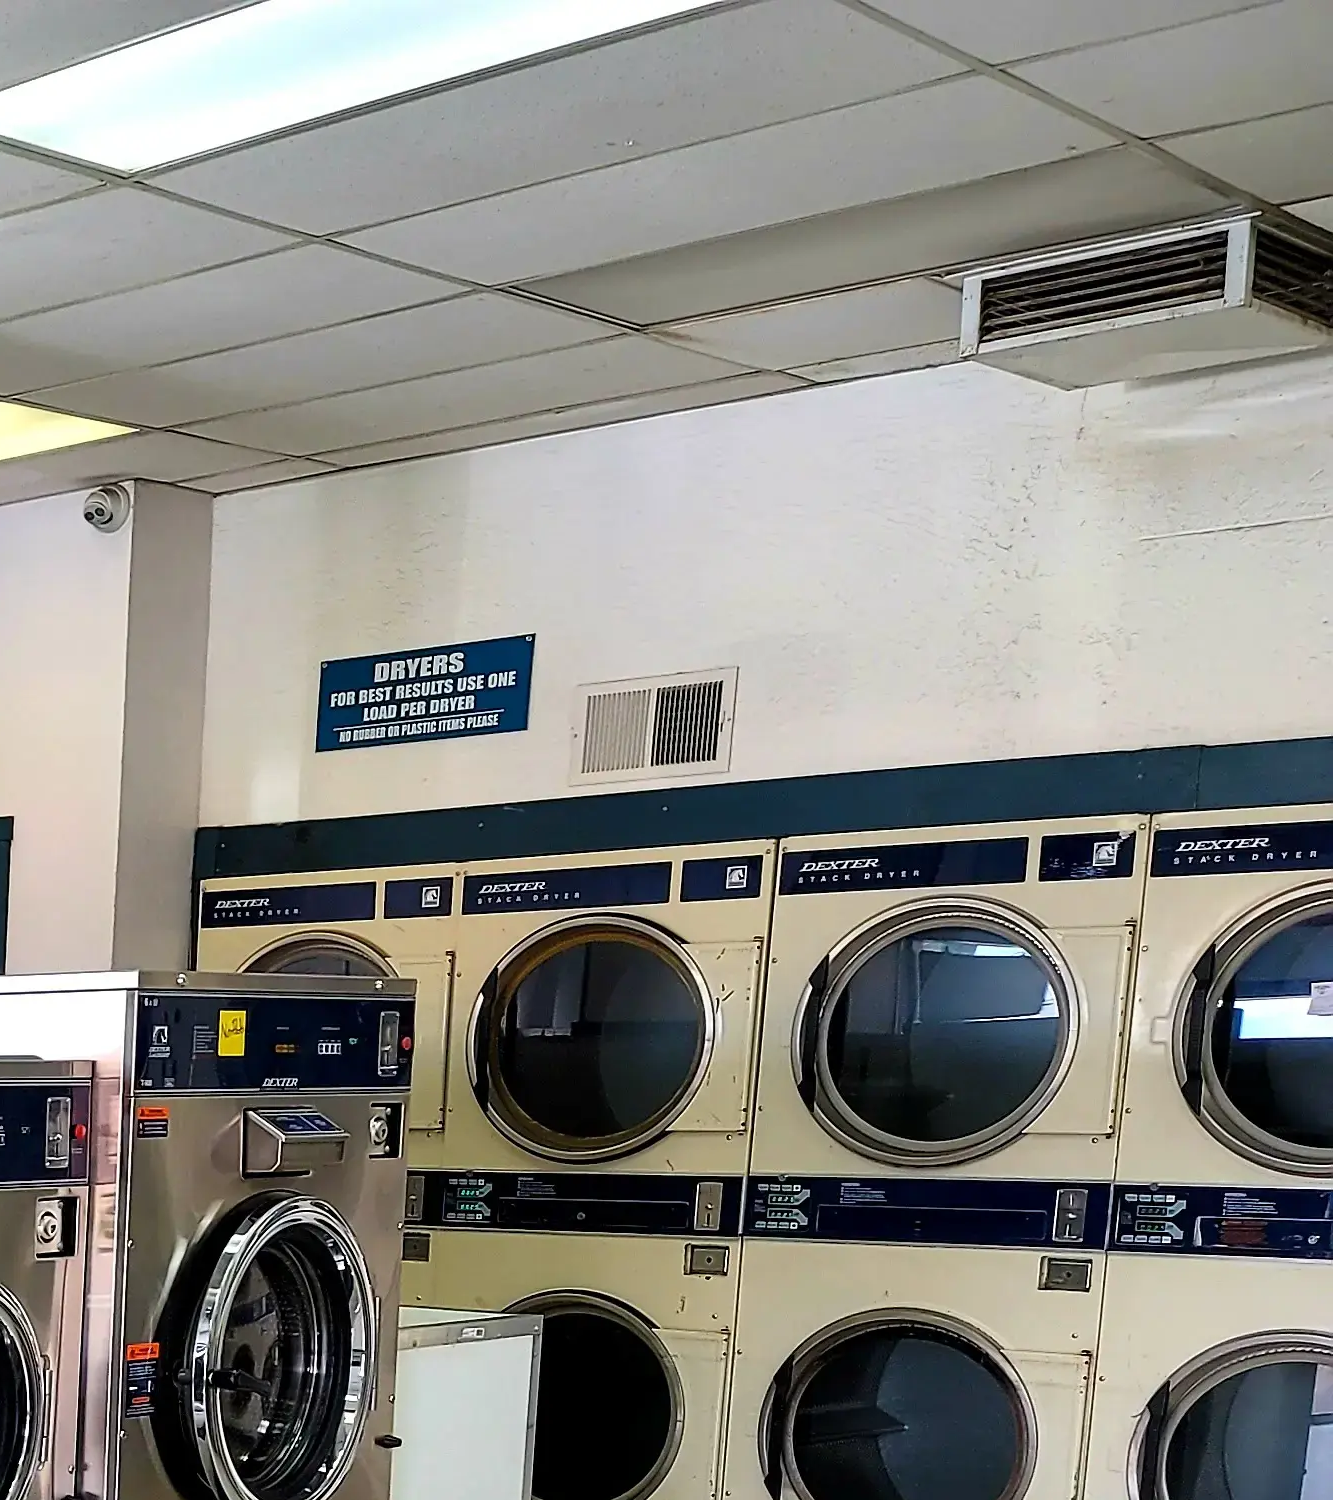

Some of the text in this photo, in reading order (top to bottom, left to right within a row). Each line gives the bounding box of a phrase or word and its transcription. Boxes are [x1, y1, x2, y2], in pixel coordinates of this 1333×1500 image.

[374, 652, 464, 682] DRYERS
[330, 671, 516, 707] FOR BEST RESULTS USE ONE
[363, 696, 475, 721] LOAD PER DRYER
[339, 714, 499, 742] NO RUBBER OR PLASTIC ITEMS PLEASE
[1175, 838, 1270, 852] DEXTER
[799, 858, 880, 872] DEXTER
[1173, 851, 1317, 865] STACK DRYER
[798, 870, 920, 883] STACK DRYER
[478, 881, 546, 893] DEXTER
[215, 898, 269, 908] DEXTER
[262, 1078, 298, 1087] DEXTER
